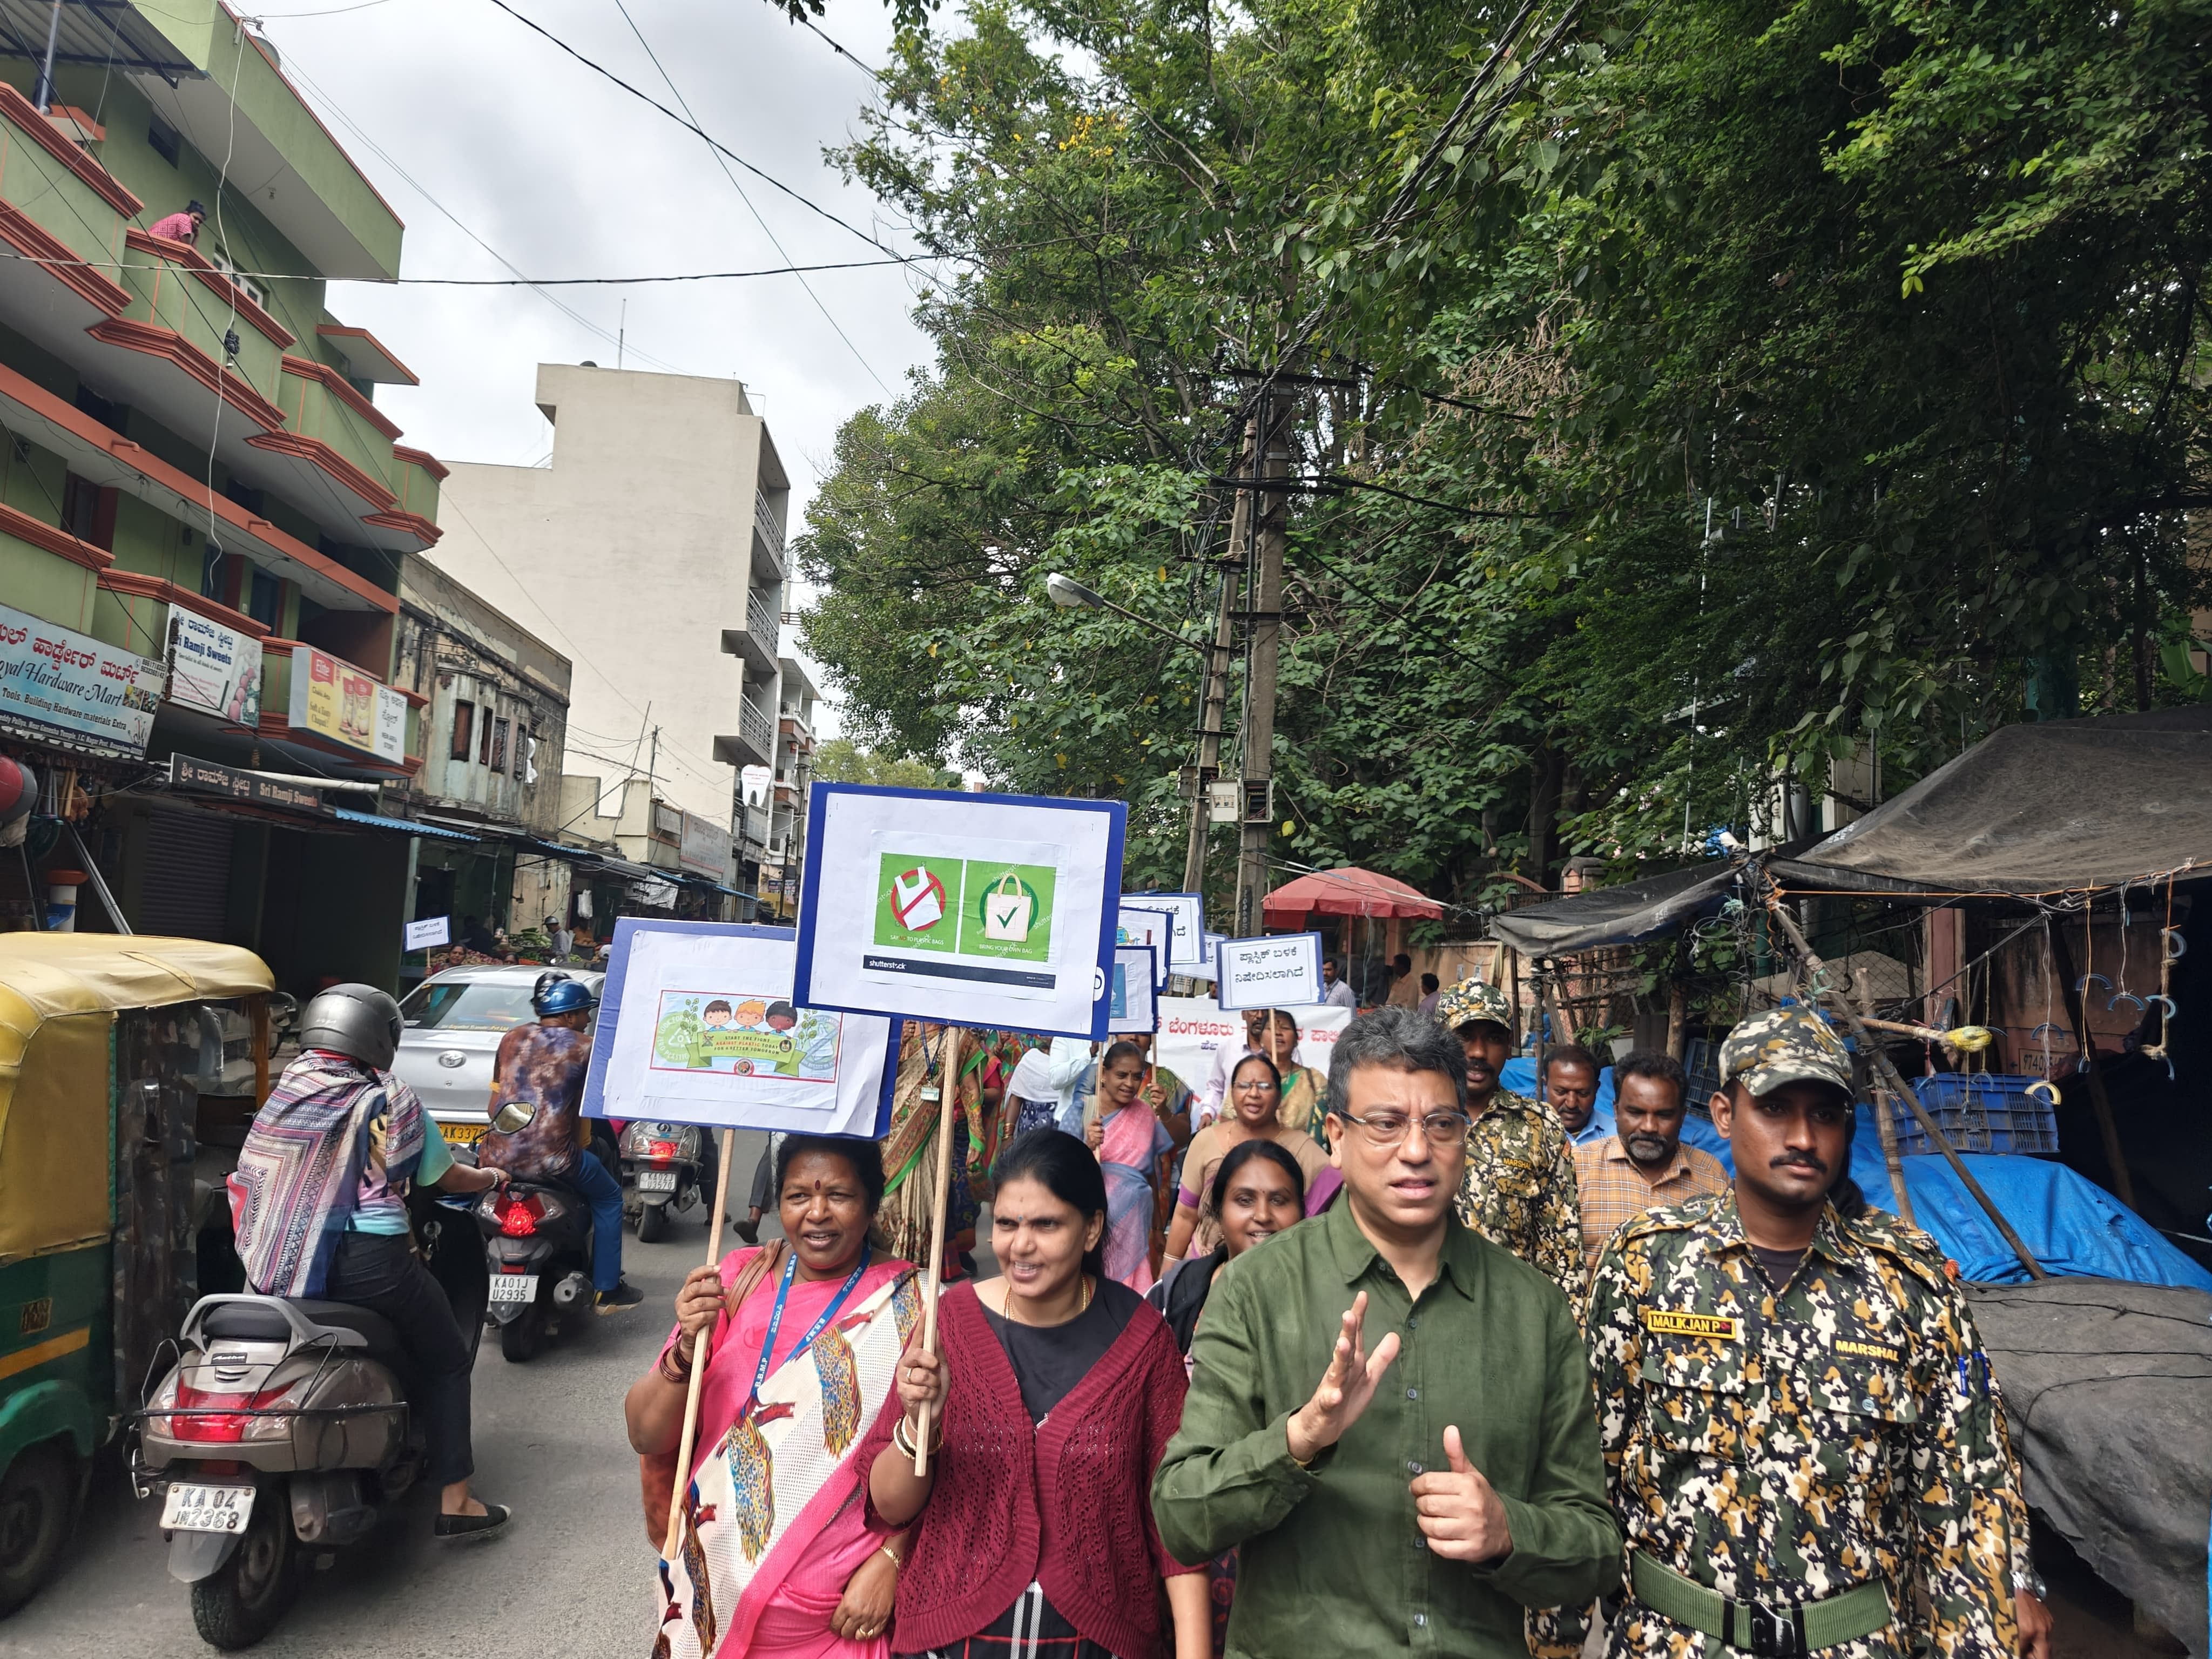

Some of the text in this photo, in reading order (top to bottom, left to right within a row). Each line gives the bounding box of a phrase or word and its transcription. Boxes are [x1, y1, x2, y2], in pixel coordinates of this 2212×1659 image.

[184, 636, 205, 657] Ramji
[207, 646, 232, 665] Sweets
[25, 662, 84, 696] Hardware
[85, 684, 123, 706] Mart
[24, 694, 52, 712] Building
[53, 702, 82, 718] Hardware
[84, 712, 111, 726] materials
[112, 719, 126, 730] Extra
[260, 783, 318, 807] Sri Ramji Sweets
[869, 960, 906, 970] shutterstock
[1239, 947, 1297, 963] ಪ್ಲಾಸ್ಟಿಕ್ ಬಳಕೆ
[1169, 1017, 1233, 1036] ಬೆಂಗಳೂರು
[494, 1277, 528, 1289] KA01J
[493, 1289, 527, 1300] U2935
[1712, 1321, 1721, 1333] P
[1836, 1340, 1899, 1363] MARSHAL
[755, 1357, 768, 1388] B.B.M.P
[181, 1488, 238, 1510] KA 04
